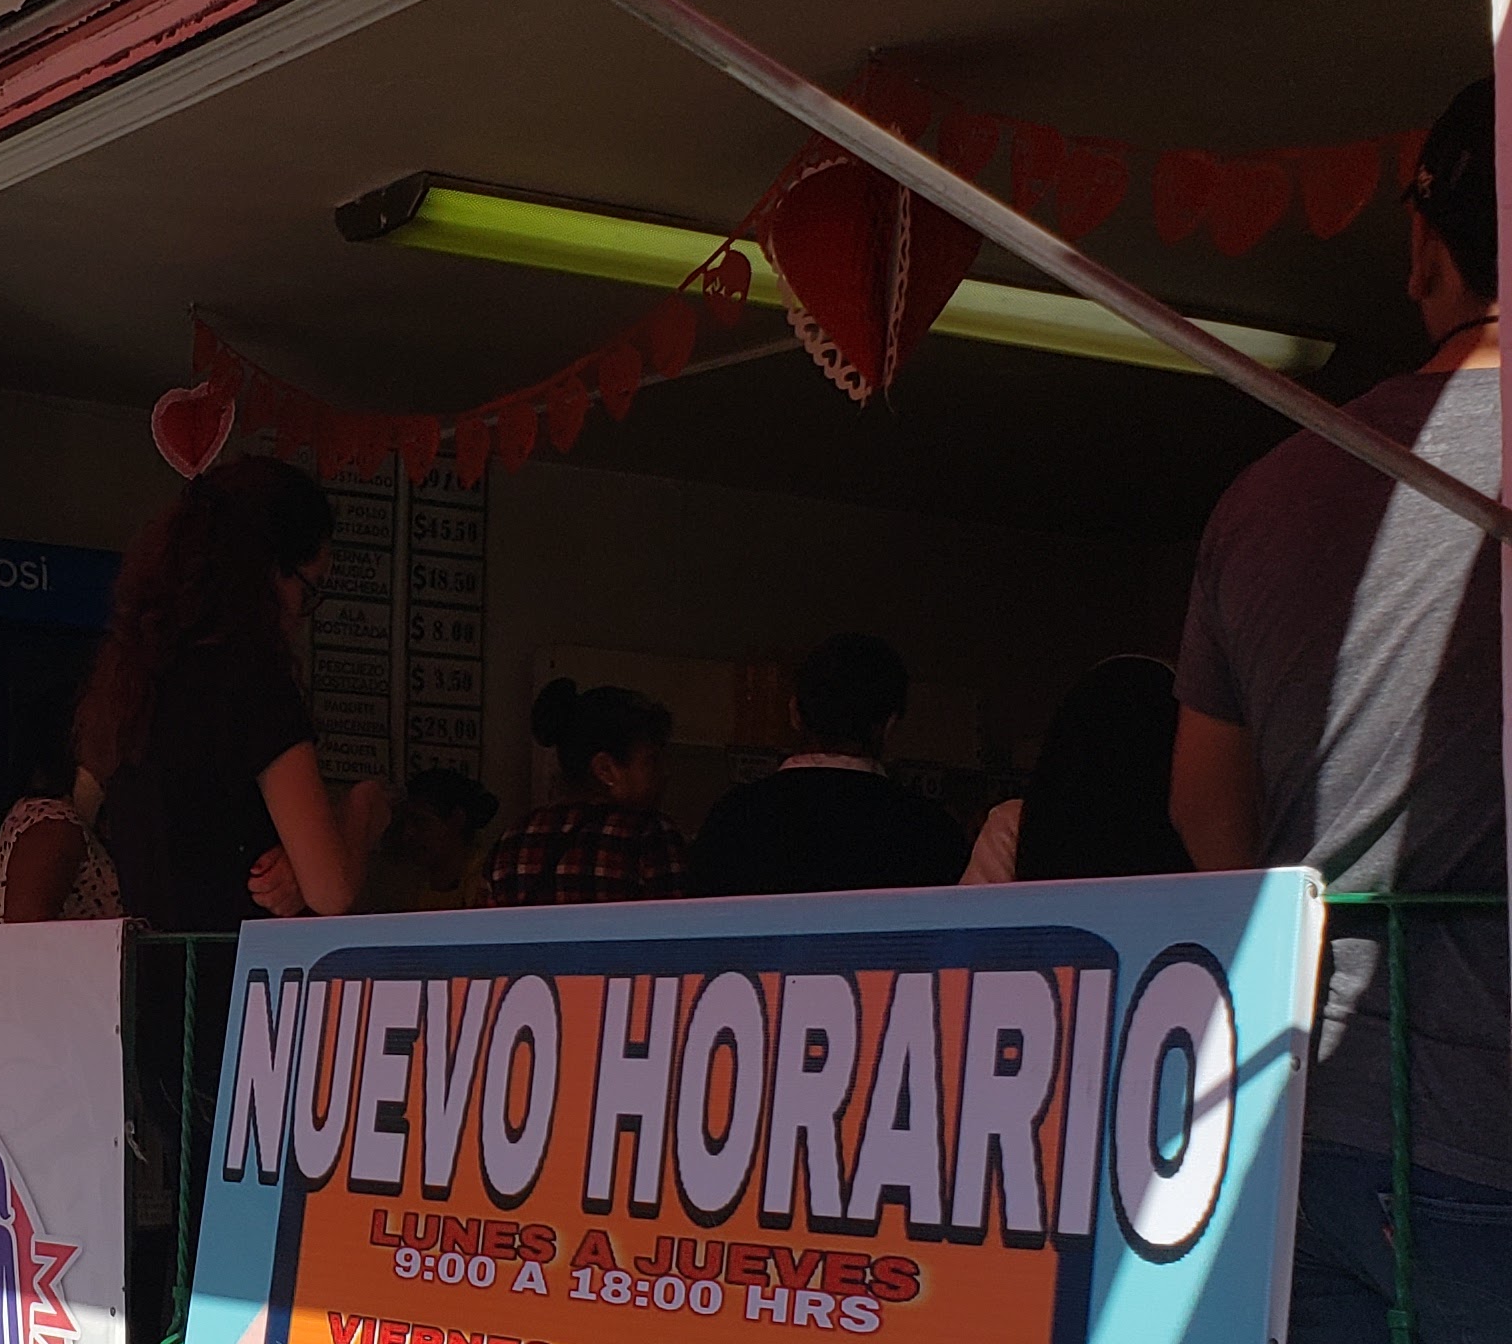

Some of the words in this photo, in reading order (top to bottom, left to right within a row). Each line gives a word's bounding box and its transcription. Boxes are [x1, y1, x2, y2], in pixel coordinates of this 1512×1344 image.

[223, 964, 563, 1212] NUEVO
[580, 943, 1240, 1264] HORARIO
[369, 1207, 558, 1263] LUNES
[573, 1228, 622, 1271] A
[628, 1234, 922, 1304] JUEVES
[392, 1246, 498, 1290] 9:00
[508, 1256, 551, 1297] A
[568, 1265, 727, 1319] 18:00
[745, 1282, 884, 1335] HRS
